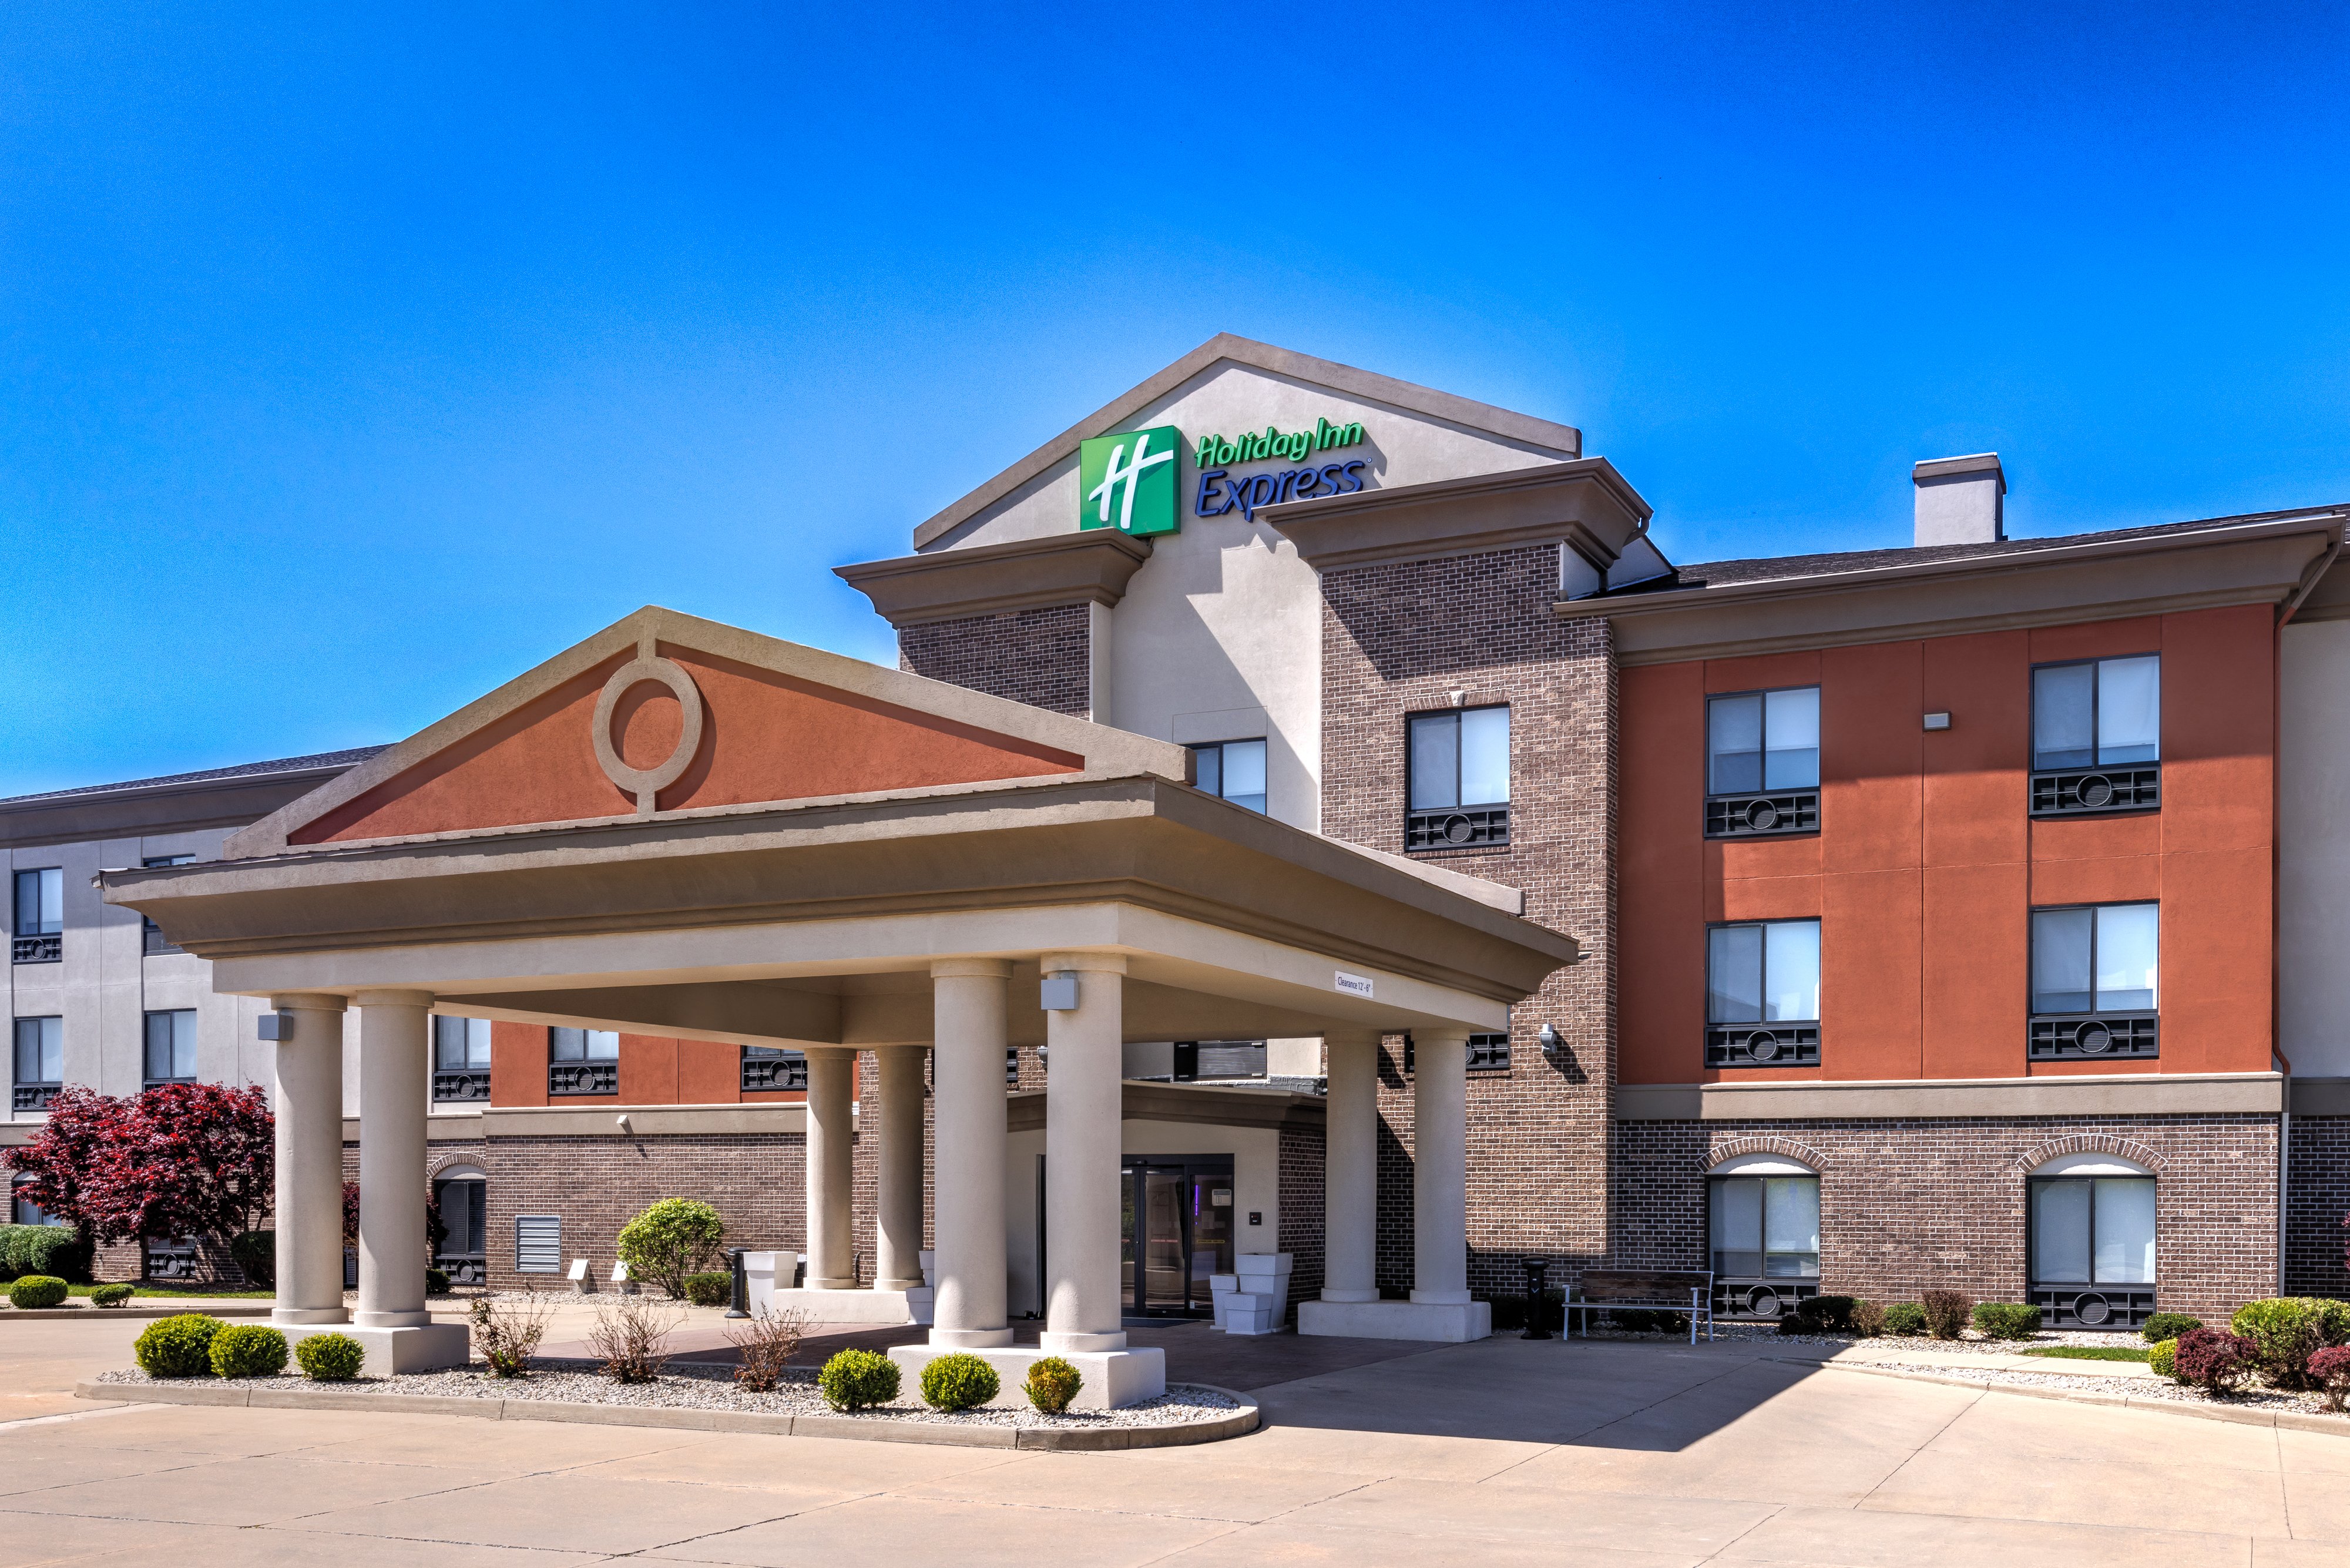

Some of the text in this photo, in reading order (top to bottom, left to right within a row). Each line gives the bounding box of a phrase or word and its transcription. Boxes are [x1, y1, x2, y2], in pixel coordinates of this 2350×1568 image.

[1194, 417, 1364, 469] Holiday Inn
[1088, 434, 1174, 529] H
[1195, 461, 1365, 523] Express
[1338, 976, 1357, 989] Clearance
